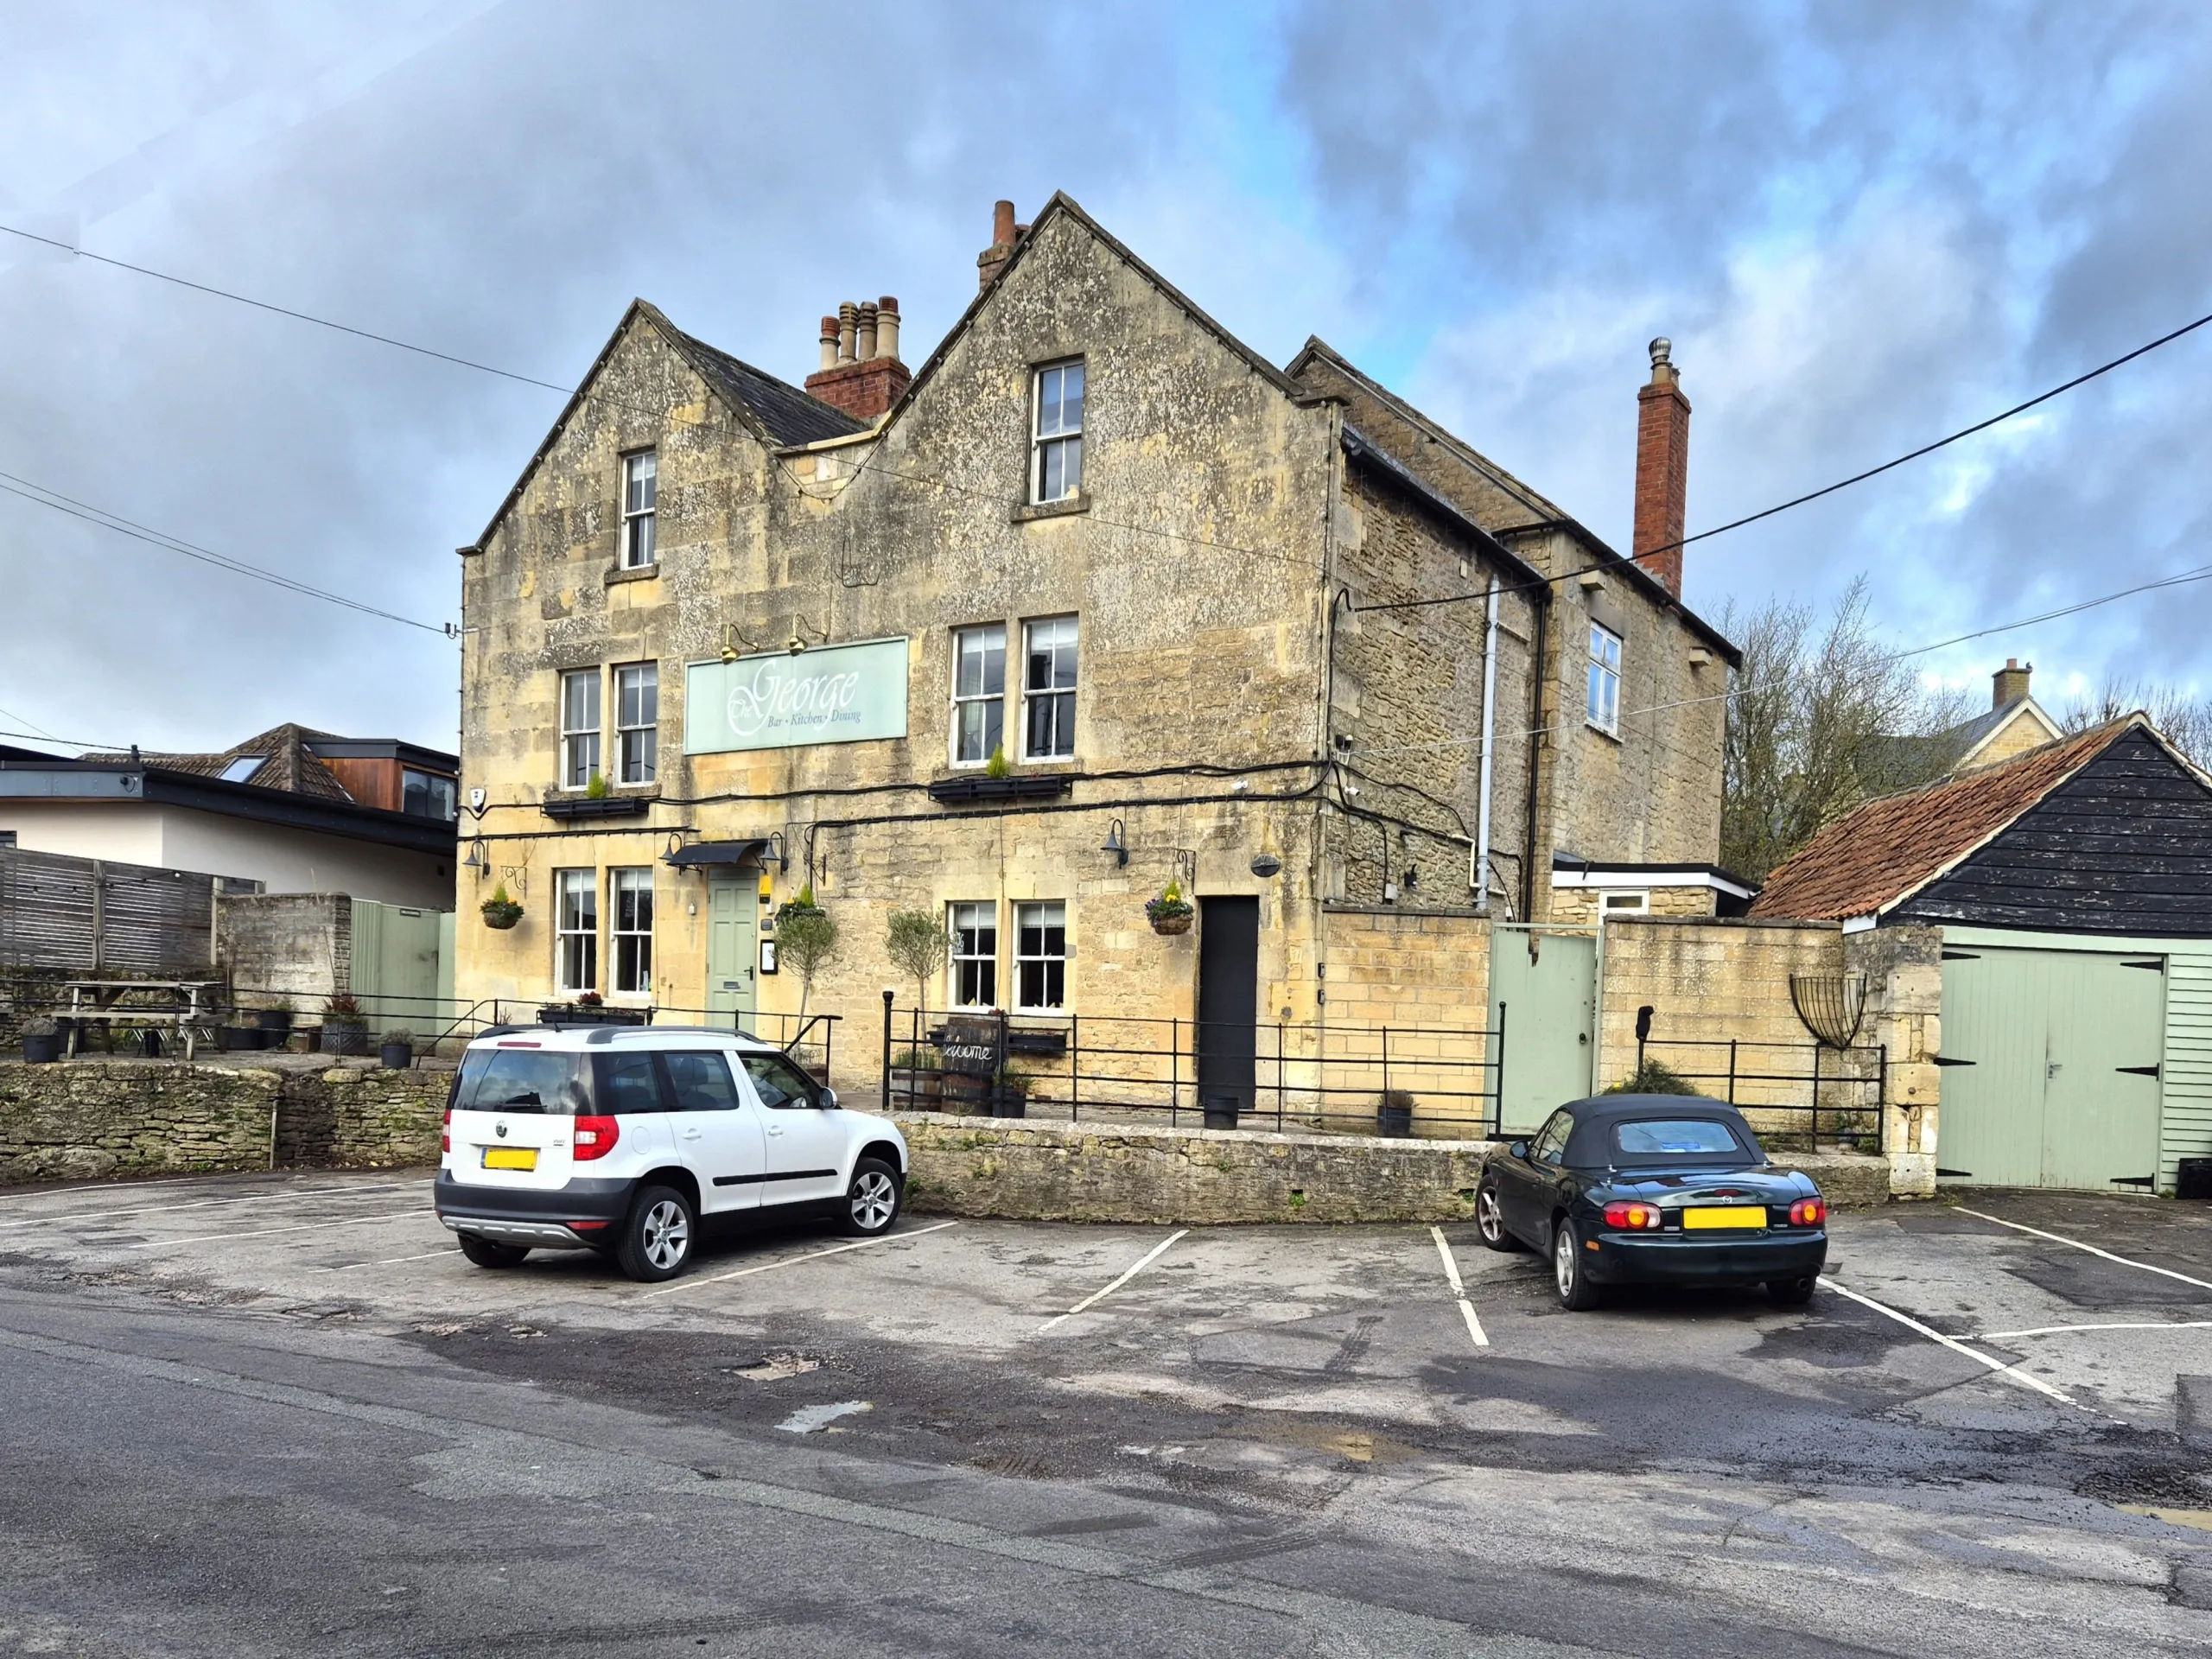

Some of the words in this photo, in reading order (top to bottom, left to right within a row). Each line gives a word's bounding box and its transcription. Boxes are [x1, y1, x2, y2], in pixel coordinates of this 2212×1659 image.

[727, 658, 860, 735] George
[731, 698, 753, 719] The
[767, 715, 783, 728] Bar
[791, 711, 823, 726] Kitchen
[830, 709, 861, 723] Dining
